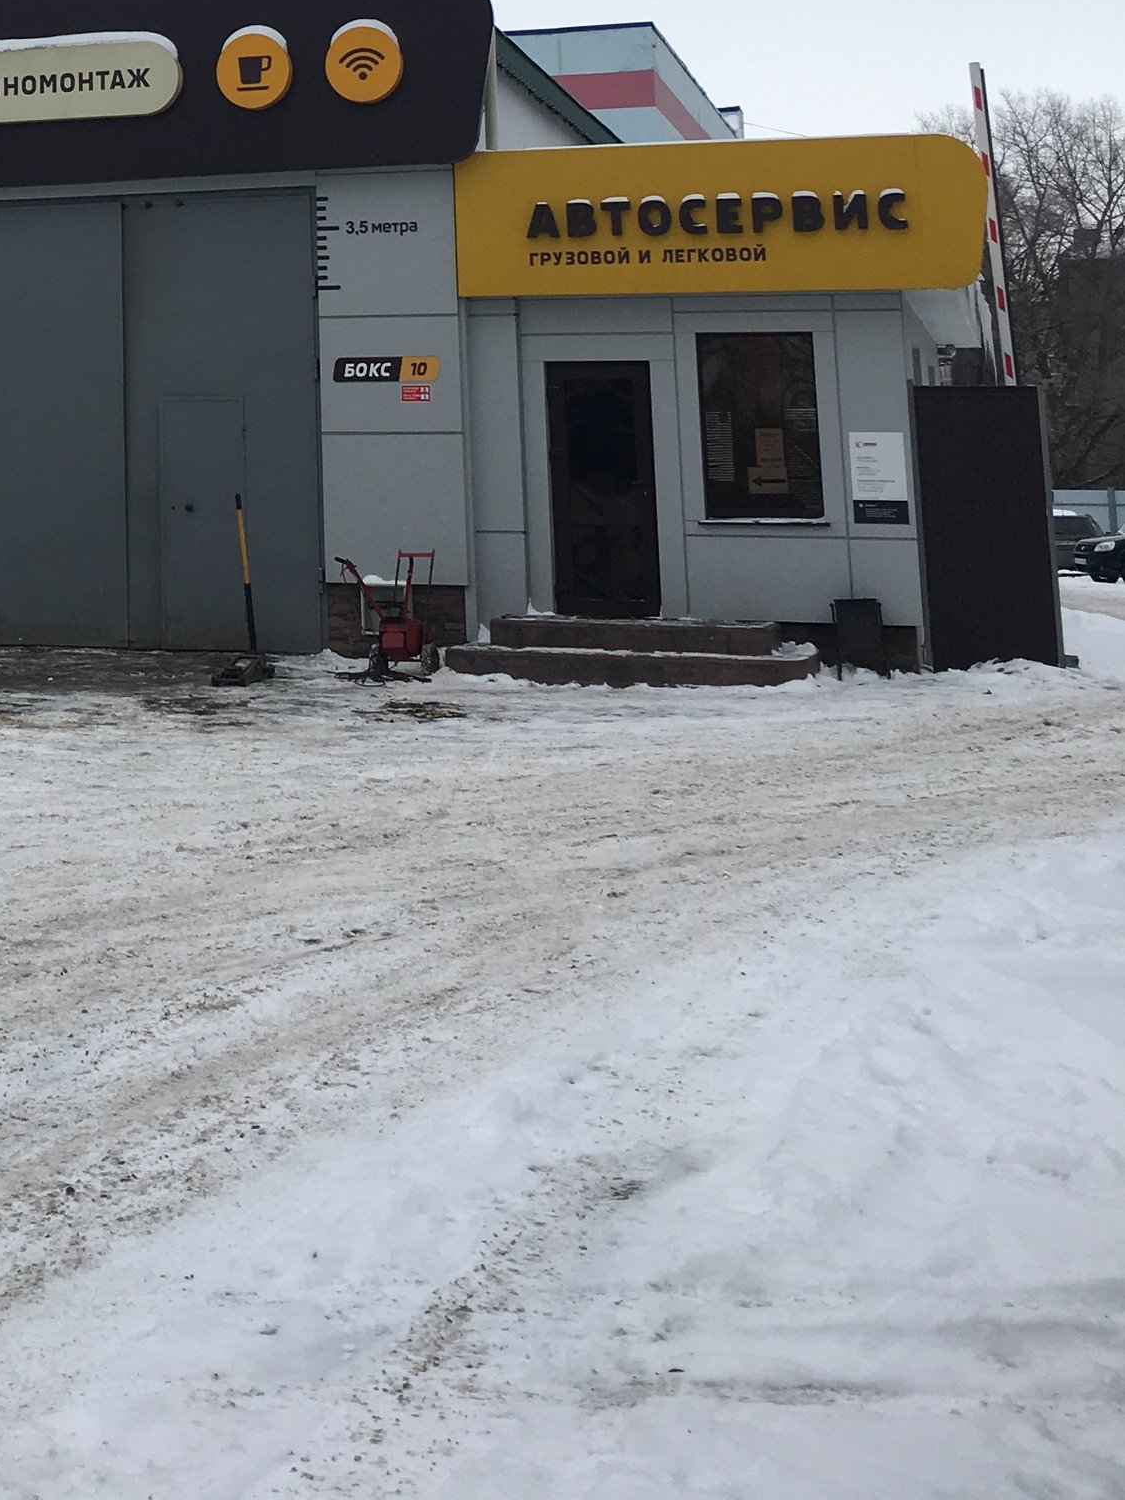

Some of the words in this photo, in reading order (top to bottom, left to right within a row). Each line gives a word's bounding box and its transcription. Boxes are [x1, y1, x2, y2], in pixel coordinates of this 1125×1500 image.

[526, 188, 909, 239] АВТОСЕРВИС
[345, 220, 369, 235] 3,5
[371, 221, 418, 236] метра
[529, 247, 630, 267] ГРУЗОВОЙ
[638, 249, 651, 264] И
[662, 244, 767, 264] ЛЕГКОВОЙ
[343, 362, 391, 377] БОКС
[410, 362, 427, 376] 10
